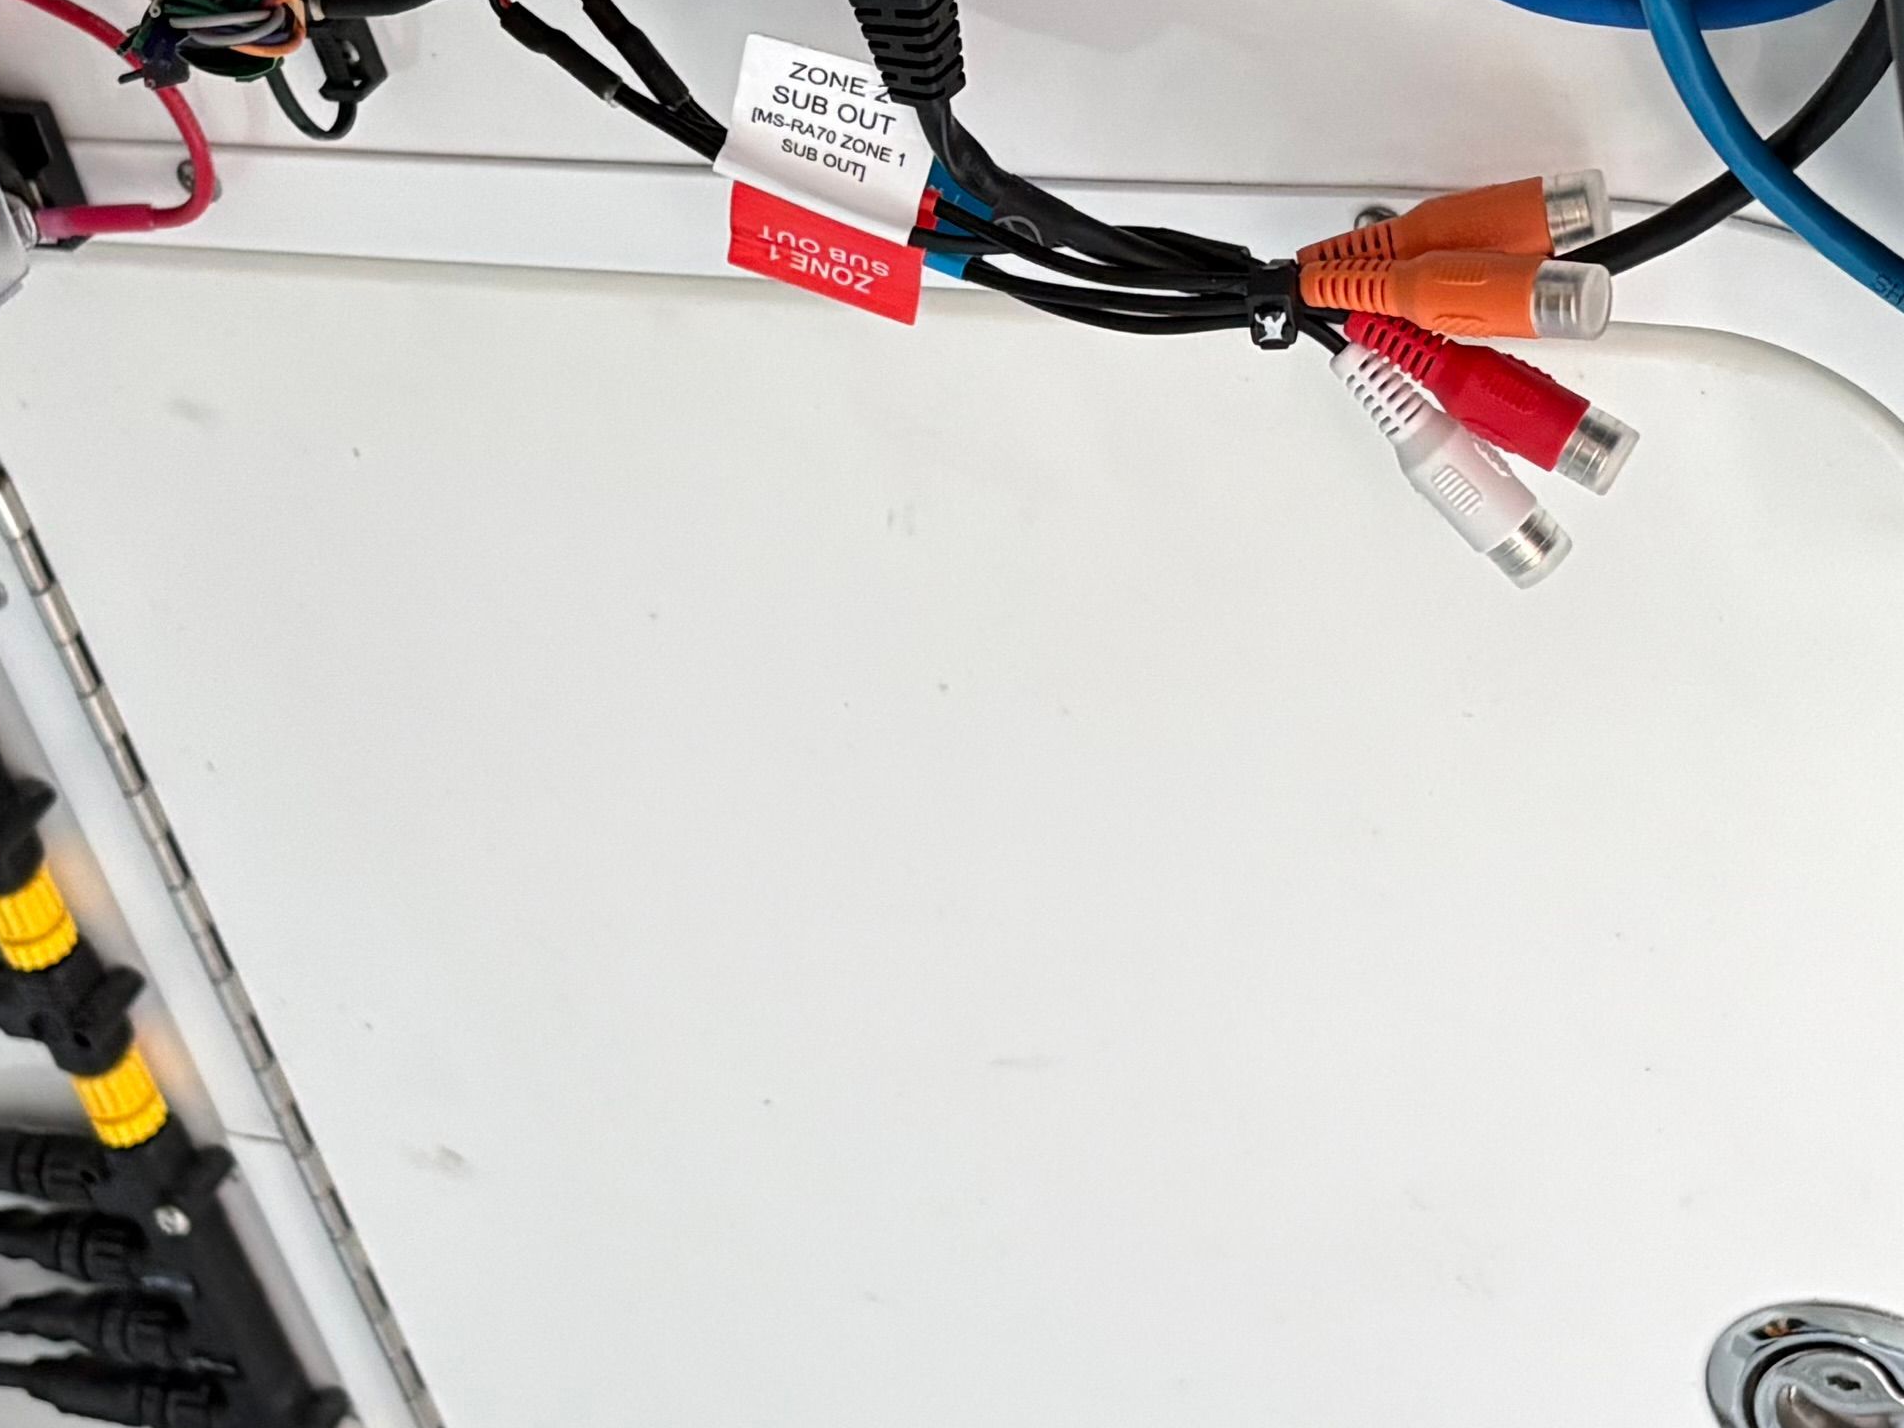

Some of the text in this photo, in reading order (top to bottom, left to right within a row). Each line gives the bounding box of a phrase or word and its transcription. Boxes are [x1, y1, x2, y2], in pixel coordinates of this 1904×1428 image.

[789, 61, 867, 98] ZONE
[772, 85, 897, 135] SUB OUT
[751, 107, 906, 168] [MS-RA70 ZONE 1
[781, 138, 866, 183] SUB OUT]
[757, 225, 890, 277] SUB OUT
[769, 243, 876, 295] ZONE 1
